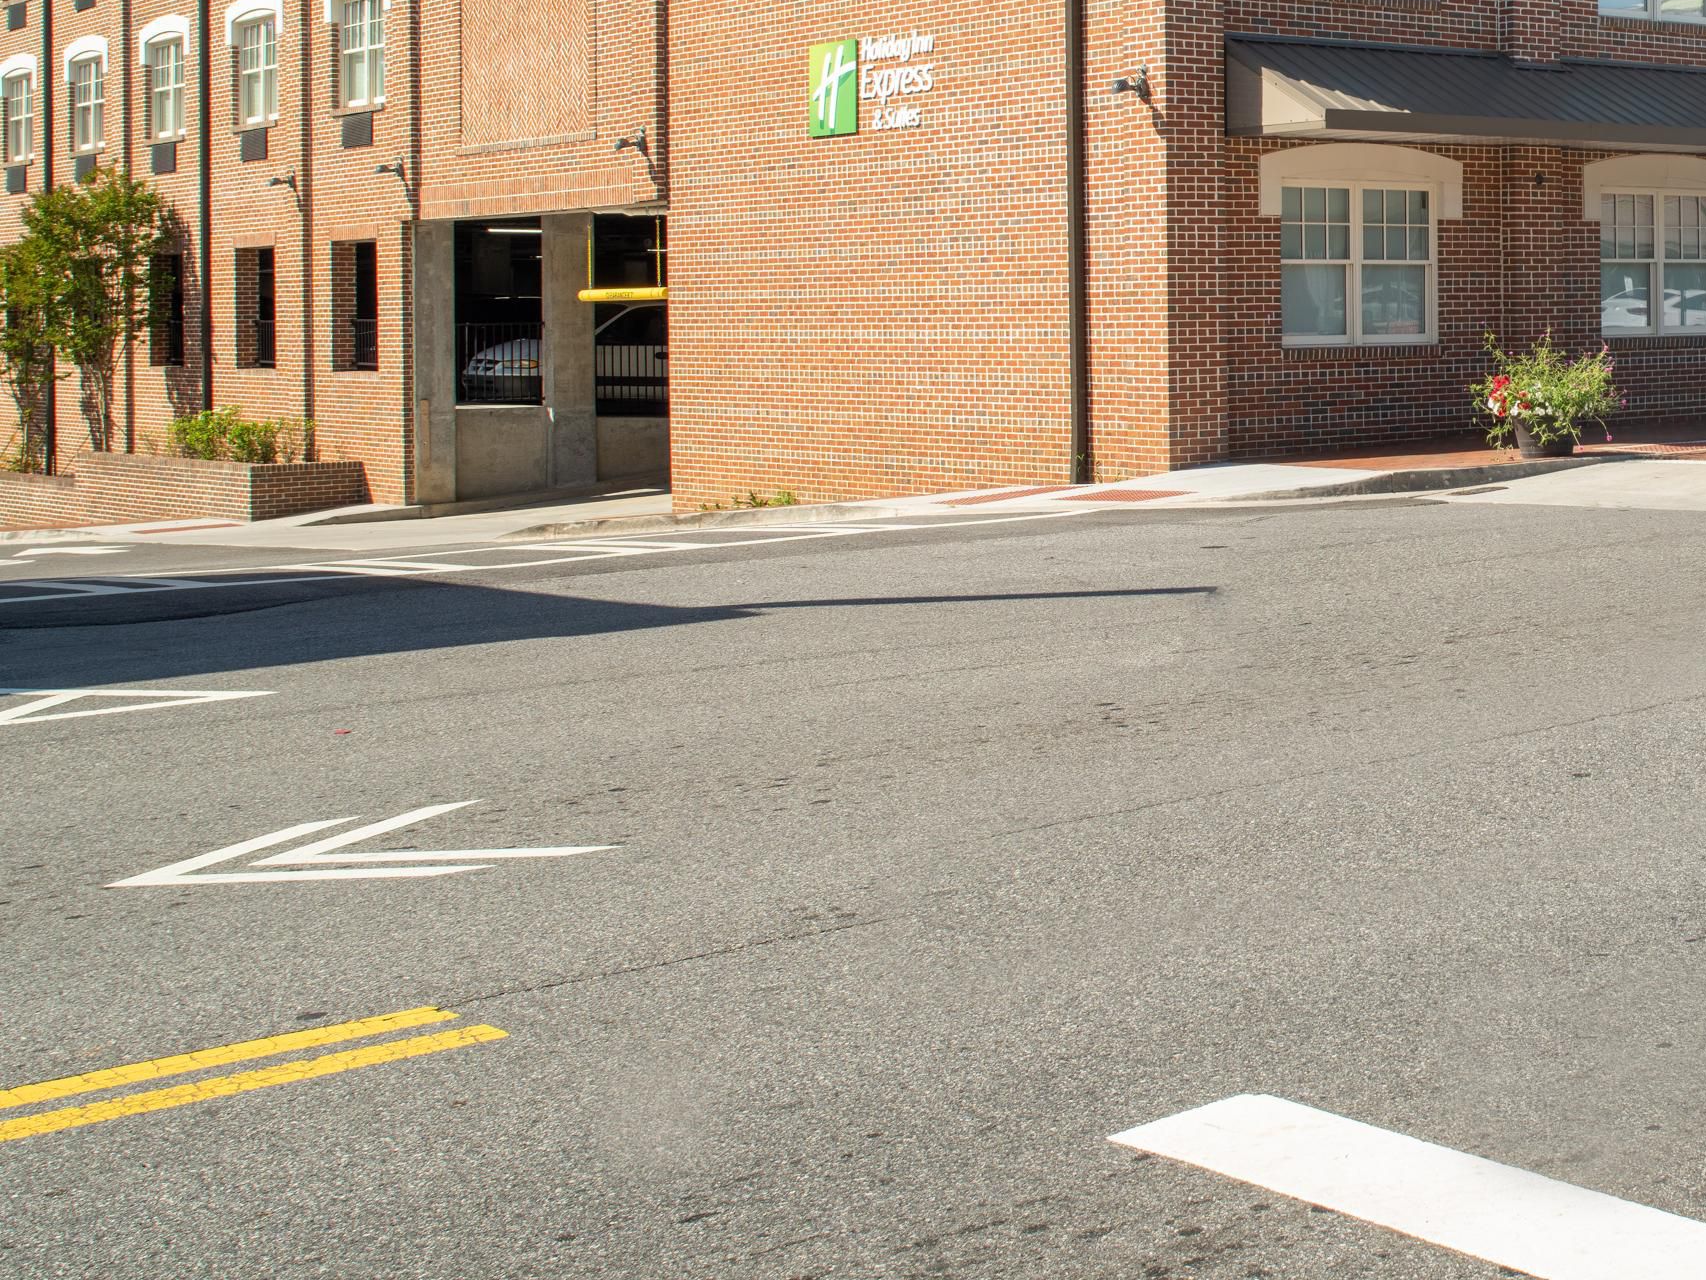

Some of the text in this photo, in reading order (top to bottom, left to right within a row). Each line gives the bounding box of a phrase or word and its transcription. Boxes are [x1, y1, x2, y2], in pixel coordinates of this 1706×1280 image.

[862, 30, 935, 62] Holiday Inn
[861, 65, 935, 105] Express
[872, 106, 921, 130] & Suites
